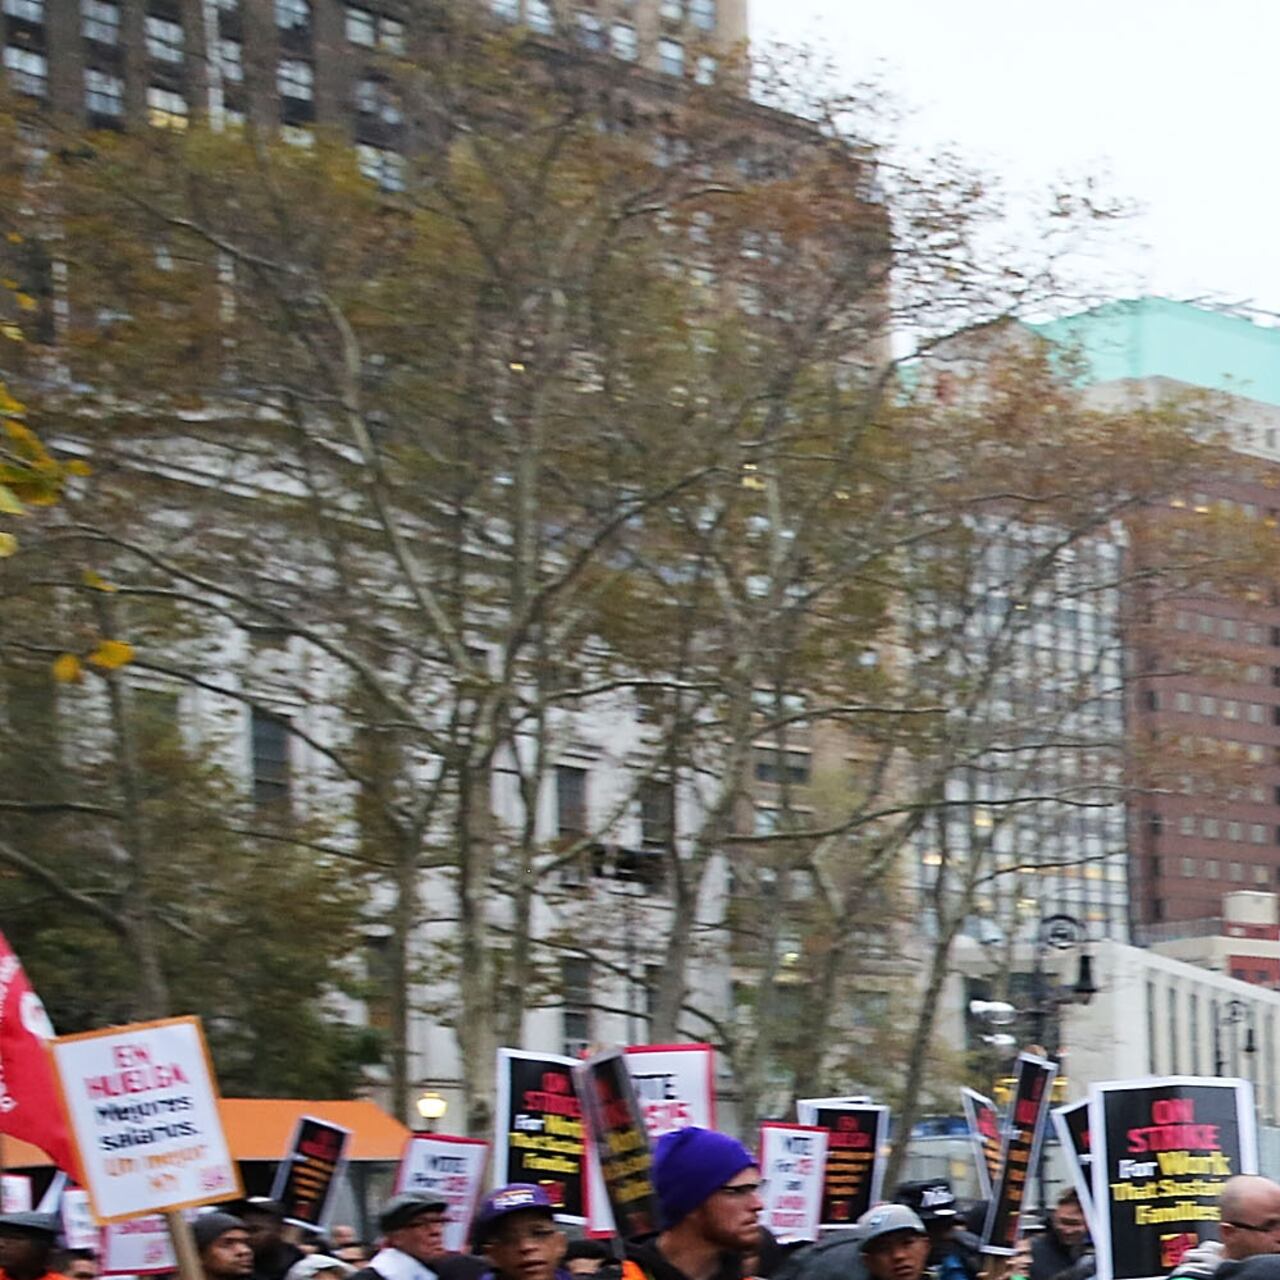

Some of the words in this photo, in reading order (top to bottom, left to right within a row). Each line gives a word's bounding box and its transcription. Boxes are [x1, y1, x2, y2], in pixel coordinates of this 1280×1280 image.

[84, 1063, 190, 1099] HUELGA
[1152, 1098, 1195, 1124] ON
[1127, 1124, 1222, 1153] STRIKE
[1119, 1159, 1157, 1179] For
[1157, 1151, 1232, 1176] Work
[1136, 1201, 1222, 1225] Families
